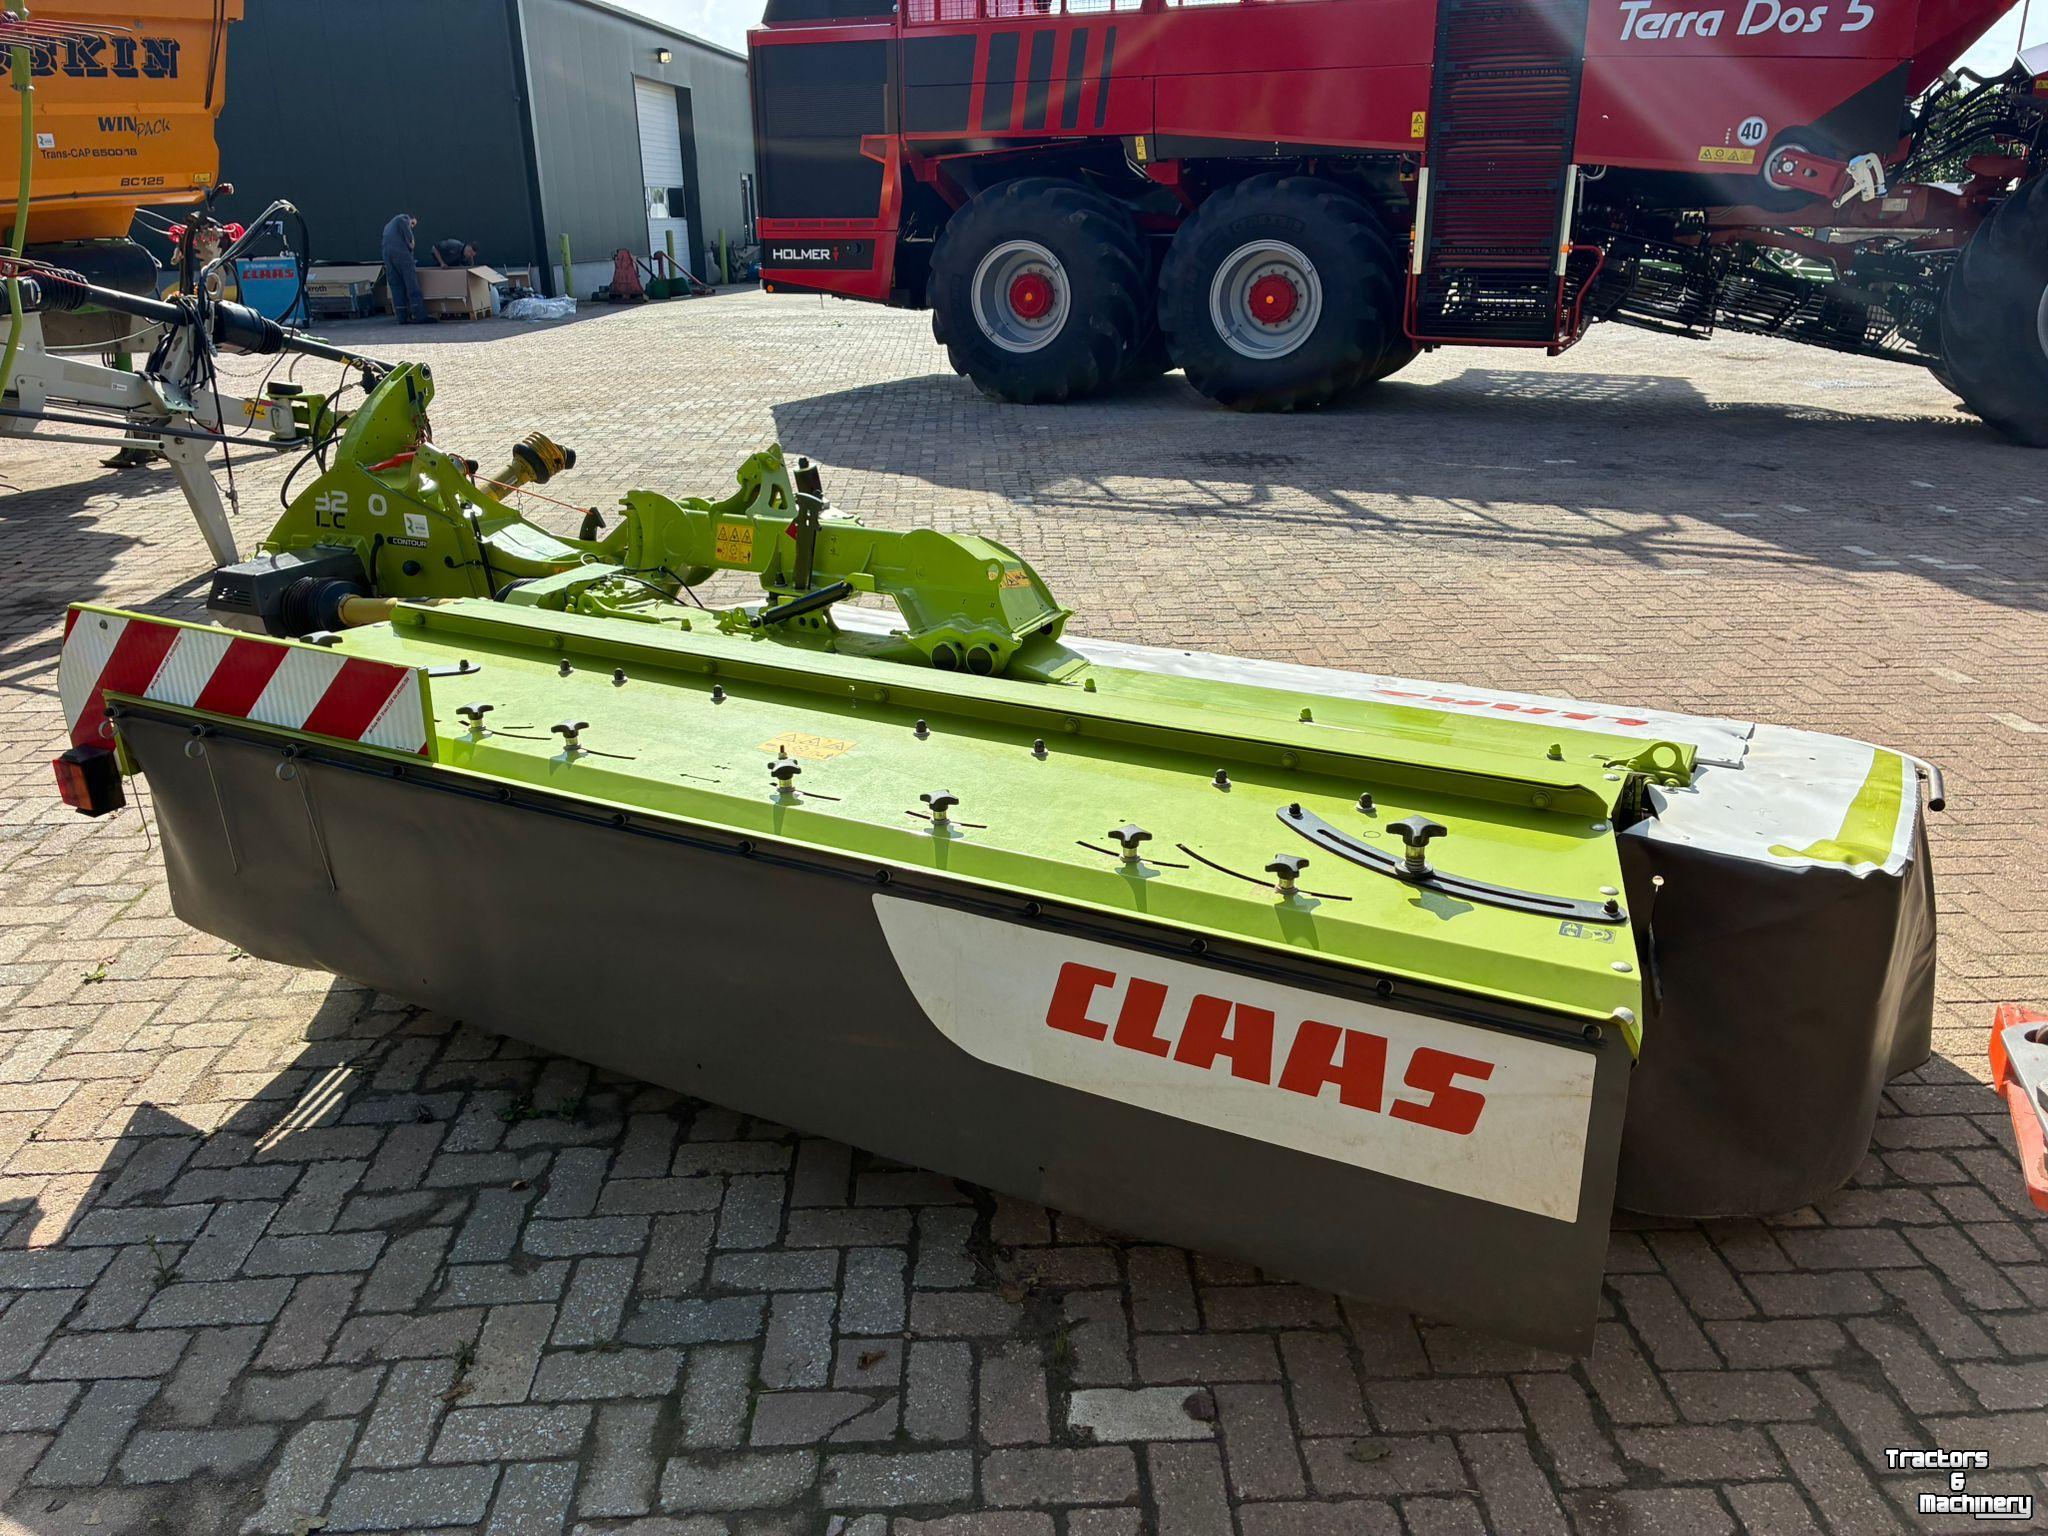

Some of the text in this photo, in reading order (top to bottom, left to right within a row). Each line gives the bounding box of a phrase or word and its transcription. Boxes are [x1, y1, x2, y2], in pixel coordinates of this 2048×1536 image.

[1620, 0, 1875, 41] Terra Dos 5
[1741, 122, 1763, 140] 40
[772, 248, 831, 260] HOLMER
[392, 537, 428, 548] CONTOUR
[1046, 961, 1496, 1136] CLAAS
